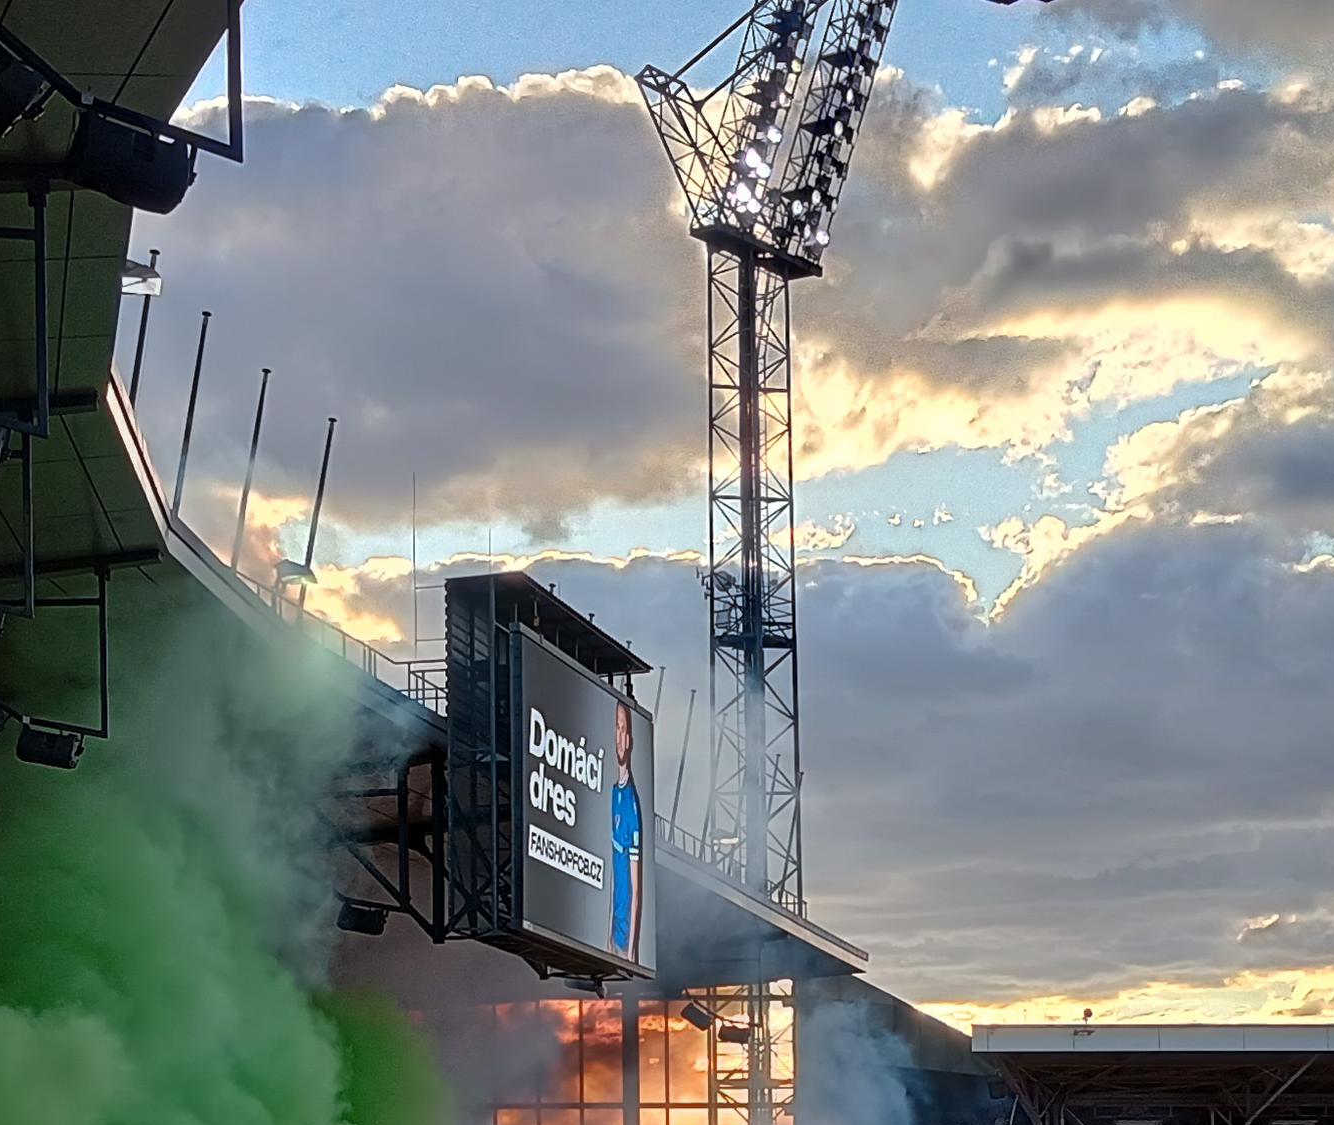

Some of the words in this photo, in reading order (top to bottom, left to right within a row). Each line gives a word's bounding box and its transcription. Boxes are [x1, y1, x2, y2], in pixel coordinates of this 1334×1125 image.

[529, 707, 604, 793] Domácí
[529, 762, 576, 827] dres
[530, 831, 602, 883] FANSHOPFCB.CZ
